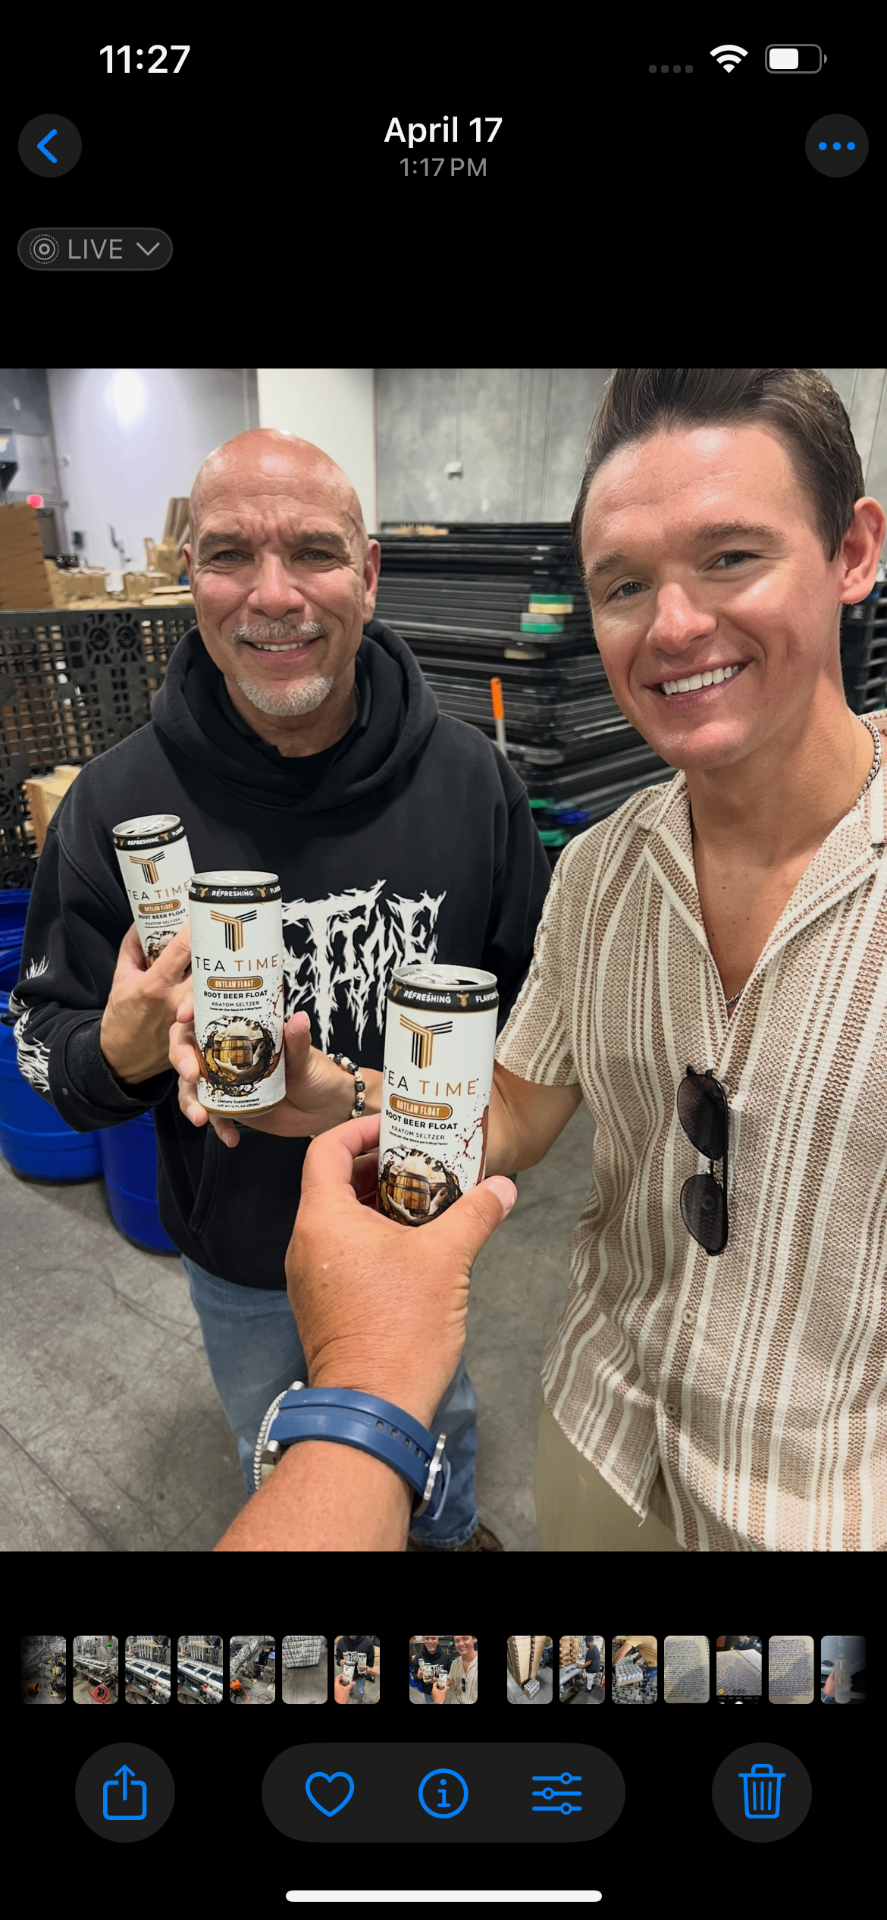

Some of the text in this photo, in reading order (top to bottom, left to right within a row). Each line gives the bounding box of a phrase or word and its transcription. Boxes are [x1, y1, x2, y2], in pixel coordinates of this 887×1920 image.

[100, 45, 190, 73] 11:27
[384, 115, 502, 148] April 17
[400, 158, 486, 176] 1:17 PM
[69, 240, 122, 259] LIVE
[127, 889, 150, 900] TEA
[154, 880, 190, 899] TIME
[168, 908, 186, 917] FLOAT
[194, 955, 278, 972] TEA TIME
[214, 980, 254, 988] OUTLAW FLOAT
[204, 990, 222, 999] ROOT
[246, 990, 268, 998] FLOAT
[403, 990, 452, 1004] REFRESHING
[418, 1080, 476, 1097] TIME
[396, 1100, 440, 1116] OUTLAW FLOAT
[386, 1110, 458, 1130] ROOT BEER FLOAT
[391, 1125, 414, 1136] KRATOM
[416, 1132, 445, 1140] SELTZER
